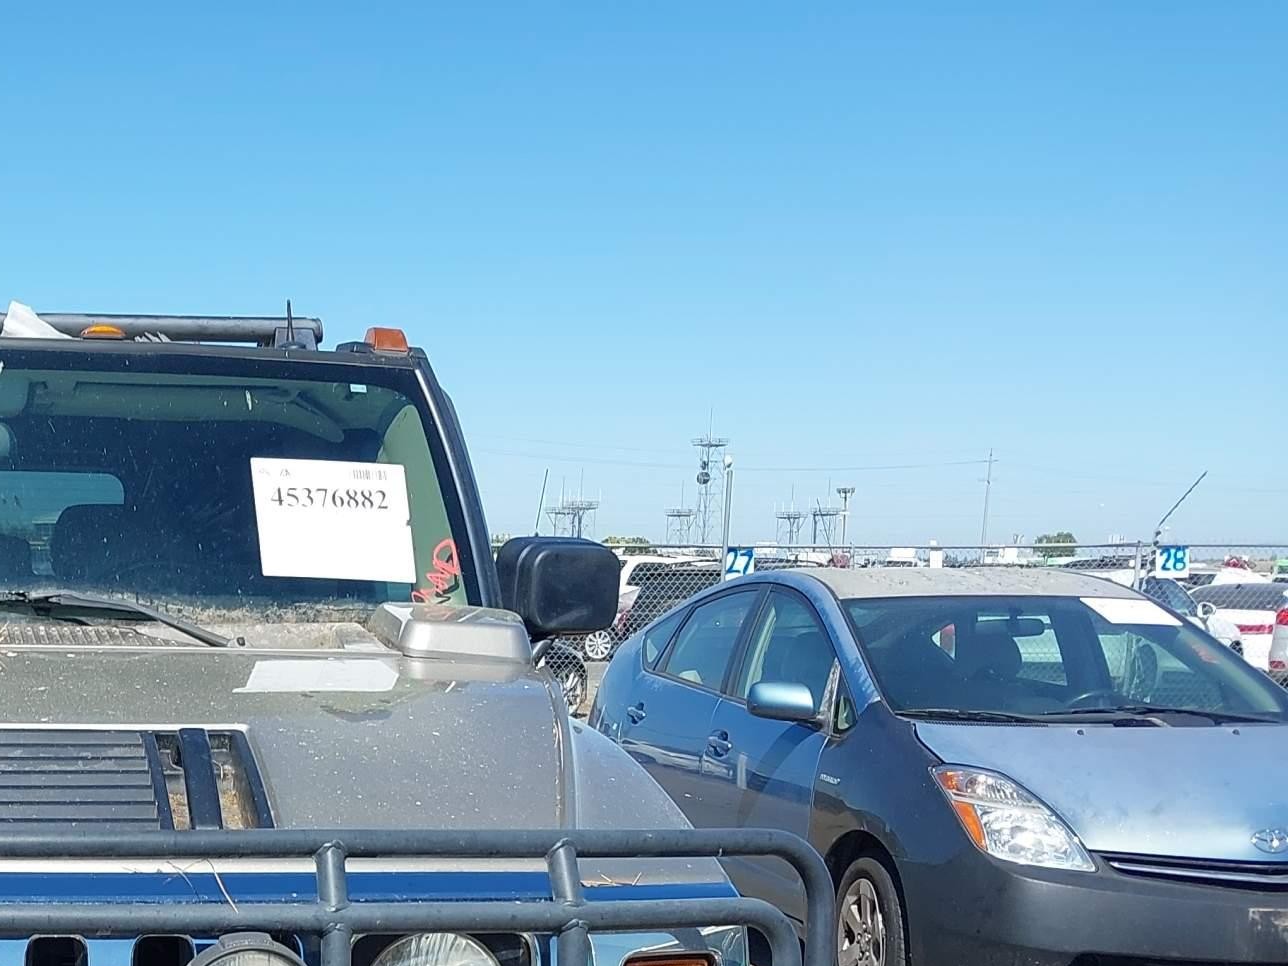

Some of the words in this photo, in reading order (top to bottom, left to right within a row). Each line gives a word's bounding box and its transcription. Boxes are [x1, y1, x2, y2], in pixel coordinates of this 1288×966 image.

[270, 487, 389, 510] 45376882
[727, 547, 754, 575] 27
[1159, 546, 1187, 572] 28
